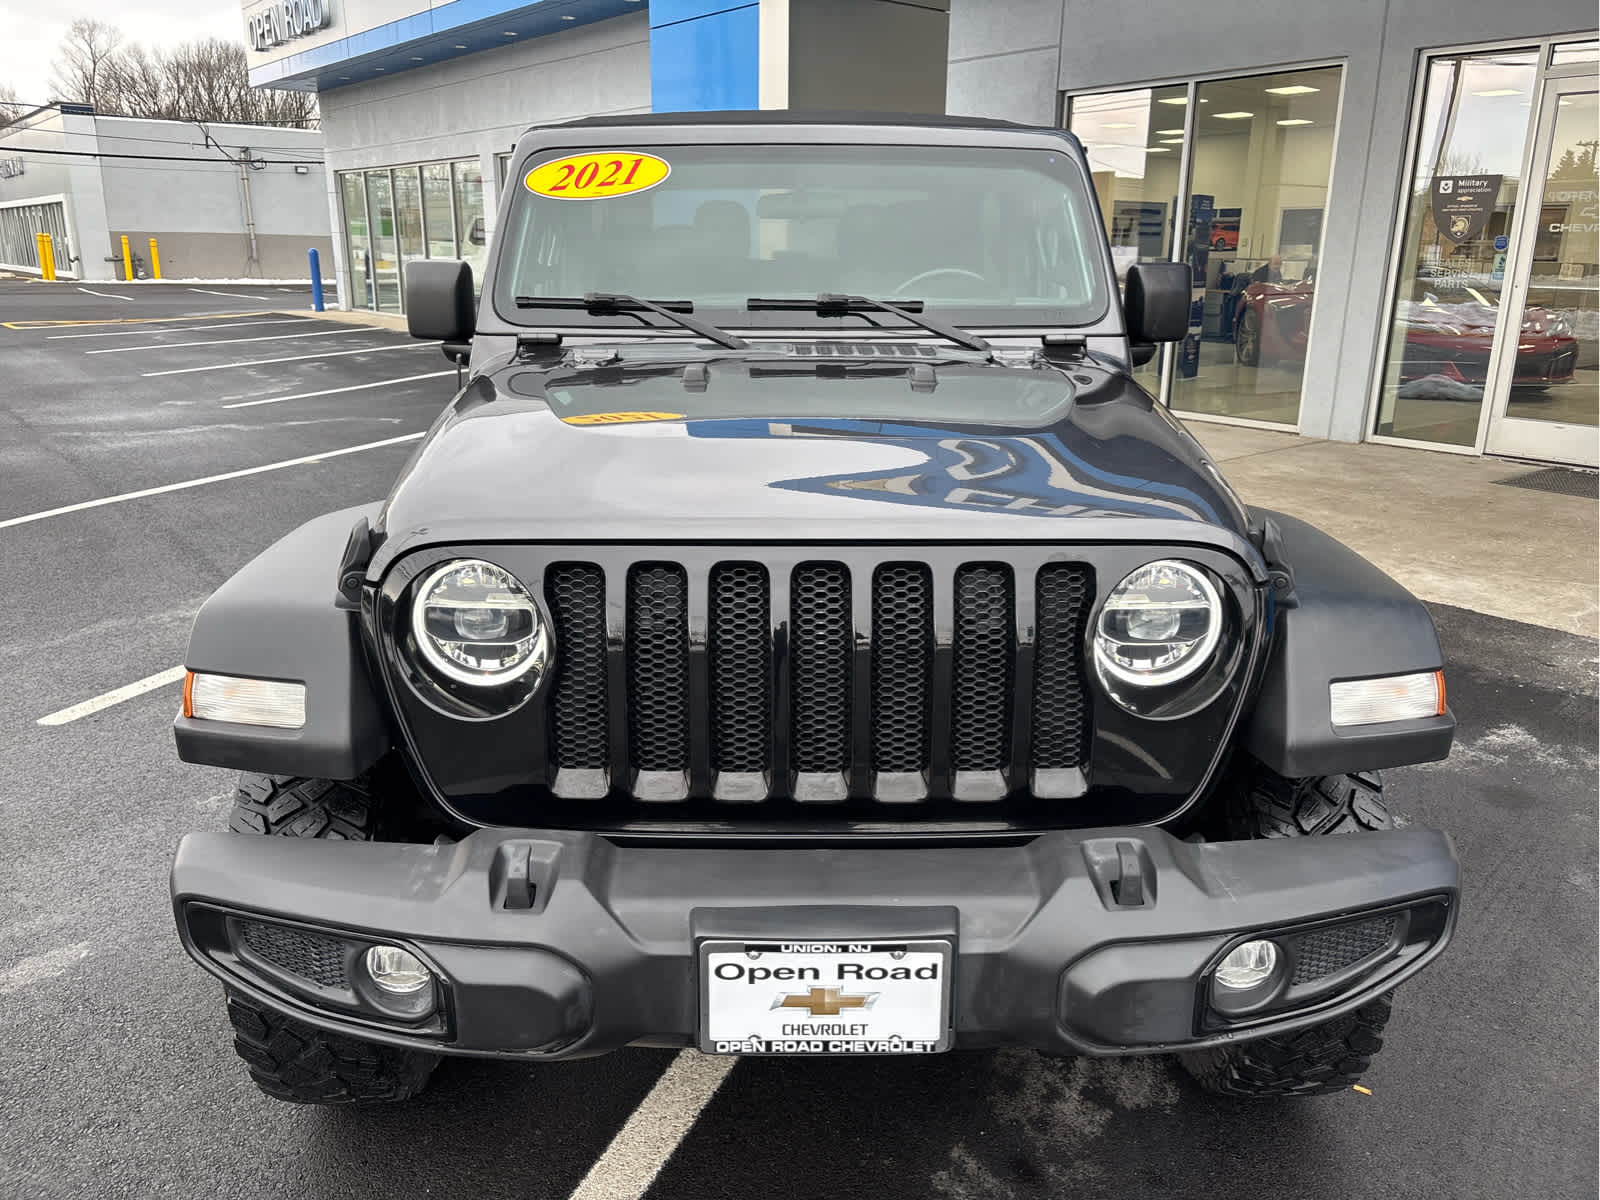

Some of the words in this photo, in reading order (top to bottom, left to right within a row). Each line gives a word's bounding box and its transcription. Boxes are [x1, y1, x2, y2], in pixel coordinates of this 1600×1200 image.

[248, 5, 281, 49] OPEN
[283, 0, 323, 36] ROAD
[548, 158, 644, 192] 2021
[1434, 279, 1469, 289] PARTS
[848, 944, 872, 953] NJ
[714, 962, 820, 985] Open
[837, 962, 938, 981] Road
[782, 1023, 869, 1036] CHEVROLET
[716, 1040, 766, 1053] OPEN
[771, 1040, 823, 1053] ROAD
[827, 1040, 935, 1053] CHEVROLET
